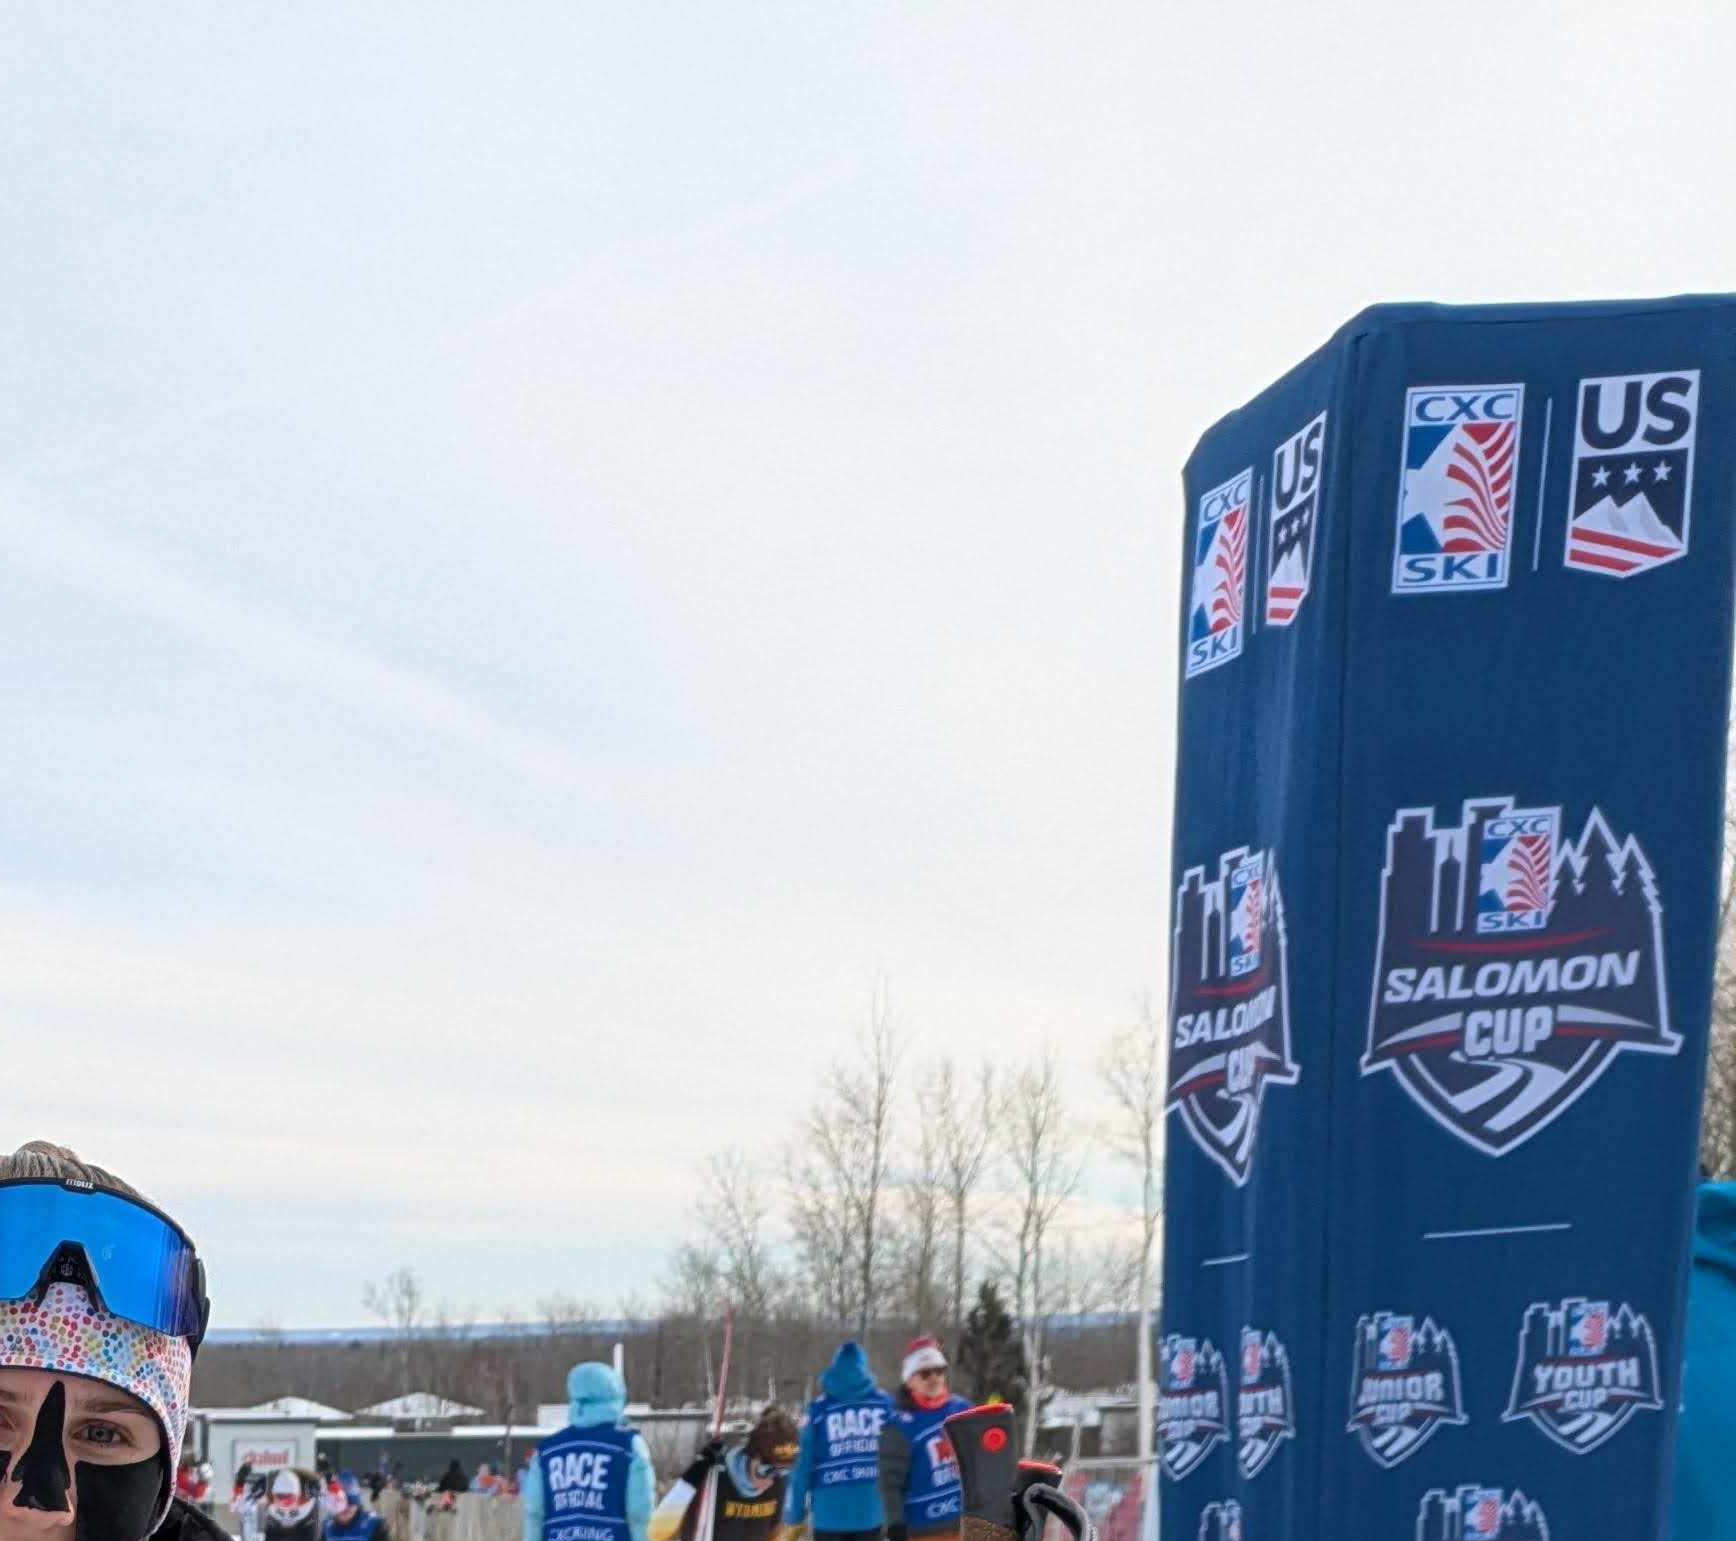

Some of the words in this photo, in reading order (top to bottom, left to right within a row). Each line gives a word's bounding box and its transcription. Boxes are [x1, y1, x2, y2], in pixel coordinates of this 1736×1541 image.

[1416, 393, 1514, 421] CXC
[1581, 377, 1694, 450] US
[1276, 421, 1320, 510] US
[1203, 480, 1247, 523] CXC
[1403, 554, 1498, 582] SKI
[1192, 632, 1238, 667] SKI
[1488, 816, 1551, 837] CXC
[1483, 912, 1543, 930] SKI
[1384, 951, 1640, 1003] SALOMON
[1464, 1005, 1555, 1057] CUP
[1533, 1358, 1640, 1394] YOUTH
[549, 1452, 612, 1491] RACE
